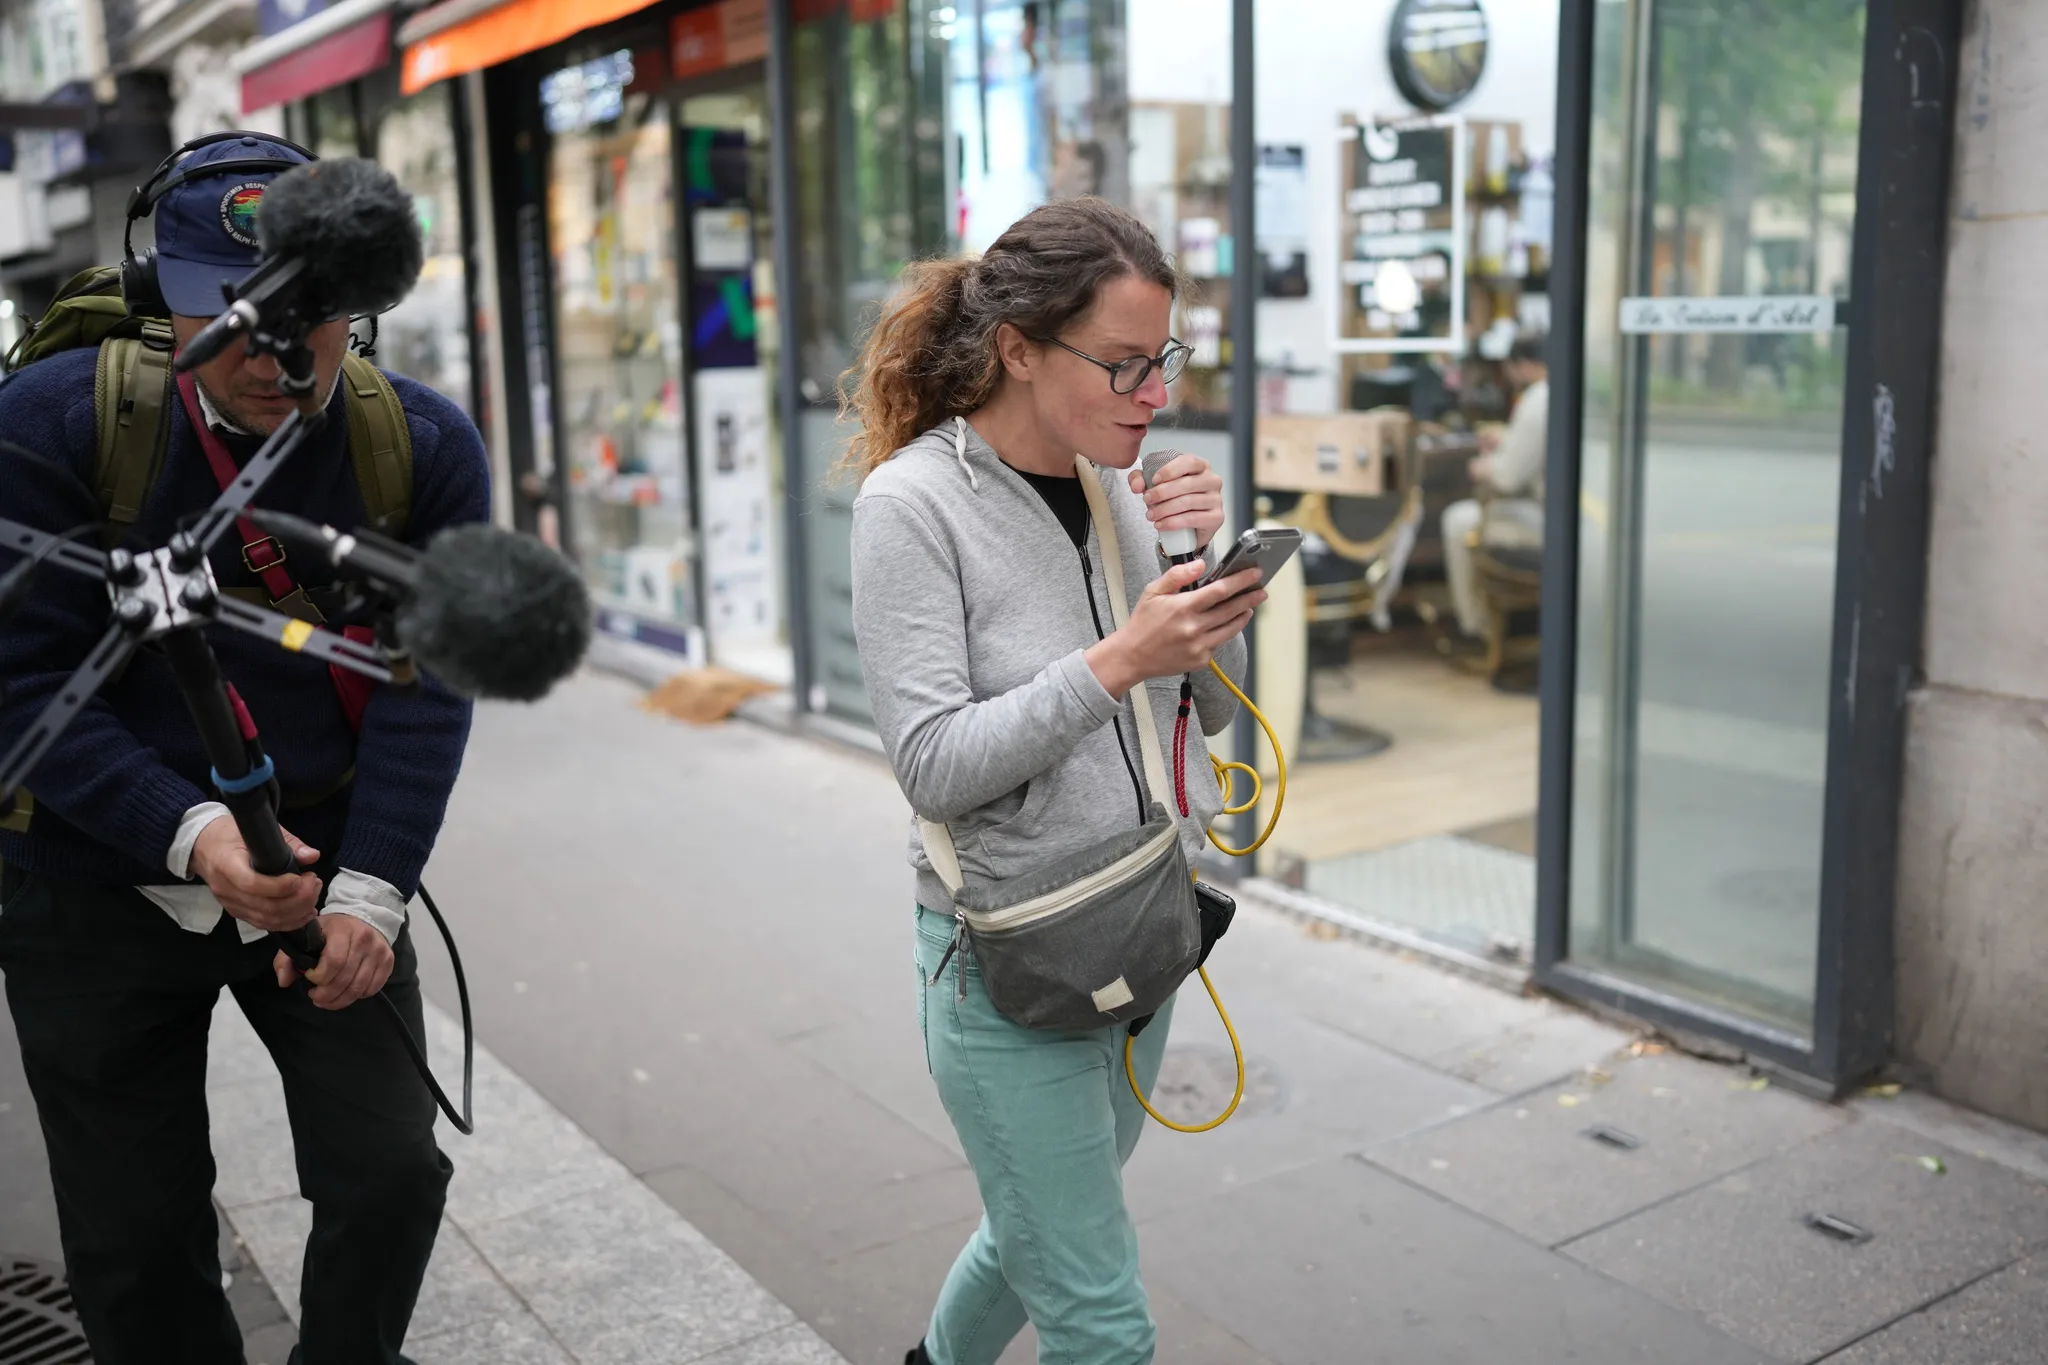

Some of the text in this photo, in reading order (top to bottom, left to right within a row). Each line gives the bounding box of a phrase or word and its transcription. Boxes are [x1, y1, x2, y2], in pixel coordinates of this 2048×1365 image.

[220, 185, 244, 213] SPORTSMEN
[222, 218, 235, 233] POLO
[231, 231, 251, 245] RALPH
